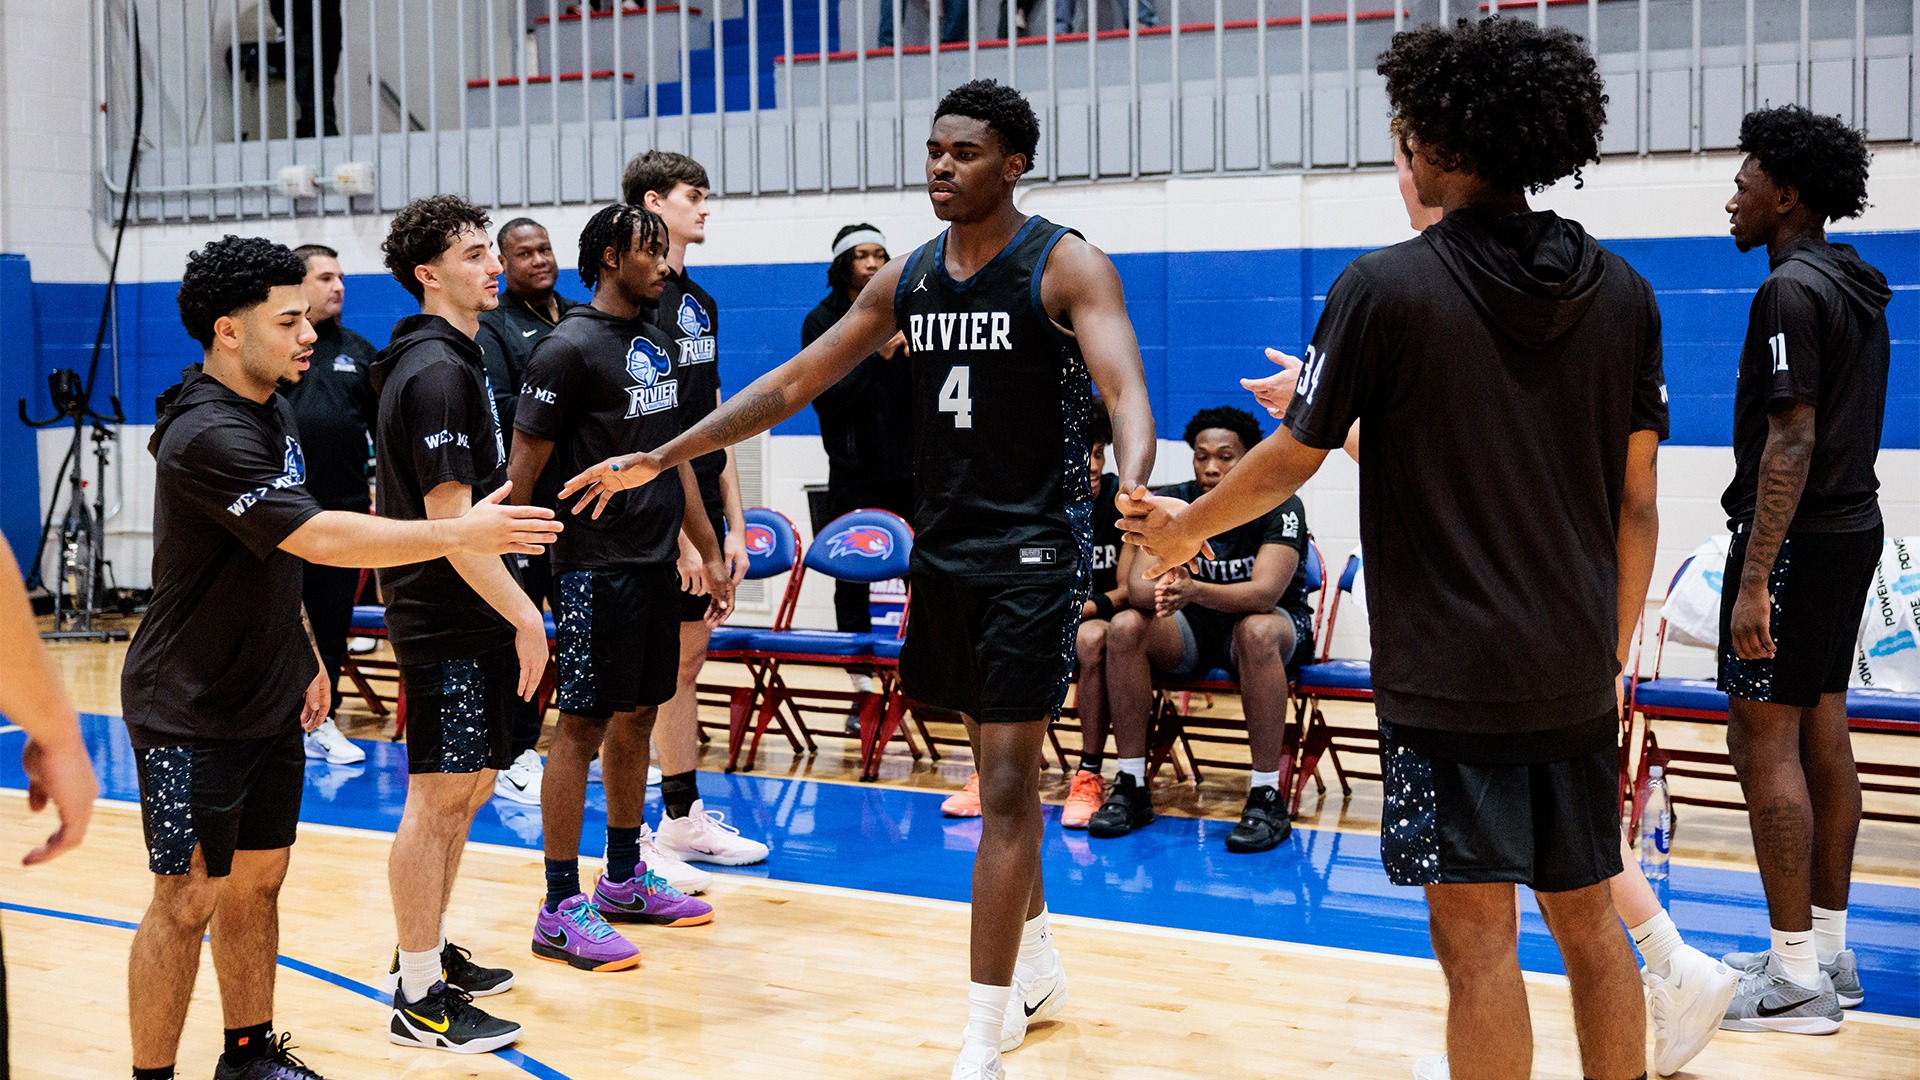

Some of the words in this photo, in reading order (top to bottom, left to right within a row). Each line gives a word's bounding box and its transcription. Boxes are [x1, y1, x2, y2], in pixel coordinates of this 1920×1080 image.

[910, 311, 1013, 352] RIVIER
[1768, 332, 1789, 375] 11
[1296, 344, 1326, 405] 34
[534, 387, 557, 404] ME
[627, 382, 678, 417] RIVIER
[938, 366, 972, 428] 4
[424, 429, 448, 449] WE
[227, 493, 257, 517] WE
[1046, 552, 1051, 560] L
